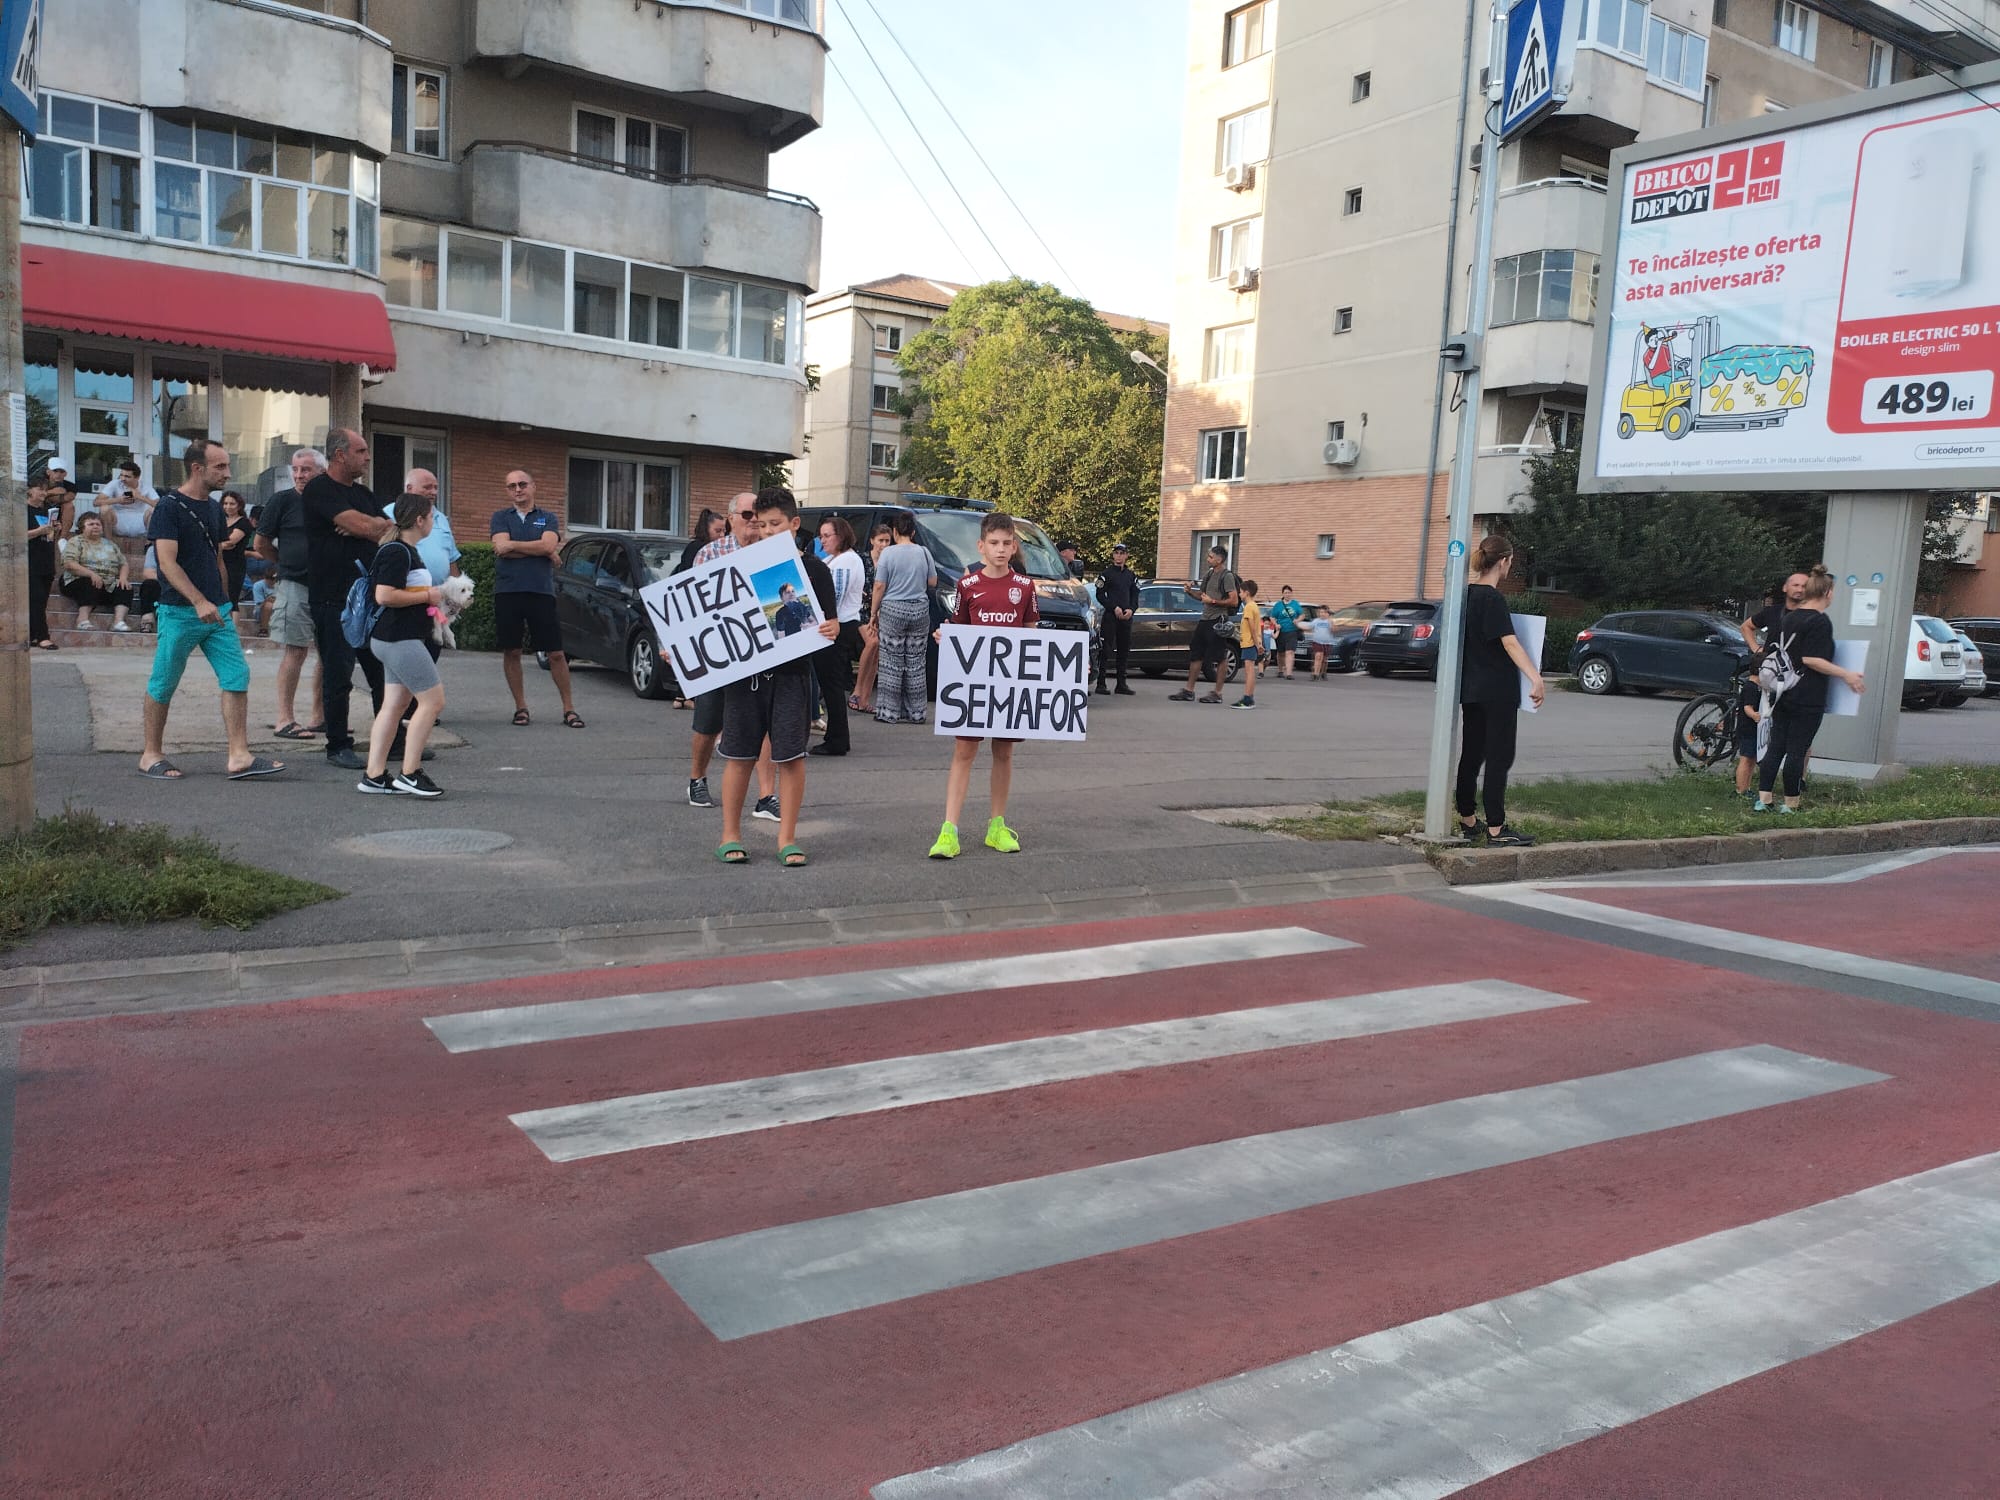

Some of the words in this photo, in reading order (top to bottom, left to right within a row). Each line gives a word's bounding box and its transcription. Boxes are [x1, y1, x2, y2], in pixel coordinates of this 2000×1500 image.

[1636, 161, 1711, 193] BRICO
[1747, 179, 1781, 204] ANI
[1633, 186, 1708, 220] DEPÔT
[1628, 258, 1648, 275] Te
[1652, 244, 1749, 273] încălzește
[1754, 233, 1822, 258] oferta
[1625, 284, 1664, 302] asta
[1669, 264, 1786, 296] aniversară?
[1840, 332, 1889, 348] BOILER
[1892, 325, 1959, 344] ELECTRIC
[1961, 323, 1980, 337] 50
[1983, 322, 1992, 335] L
[1901, 343, 1935, 357] design
[1937, 342, 1960, 353] slim
[1877, 381, 1950, 415] 489
[1952, 396, 1975, 412] lei
[1927, 446, 1985, 456] bricodepot.ro
[949, 636, 1083, 683] VREM
[940, 682, 1088, 733] SEMAFOR
